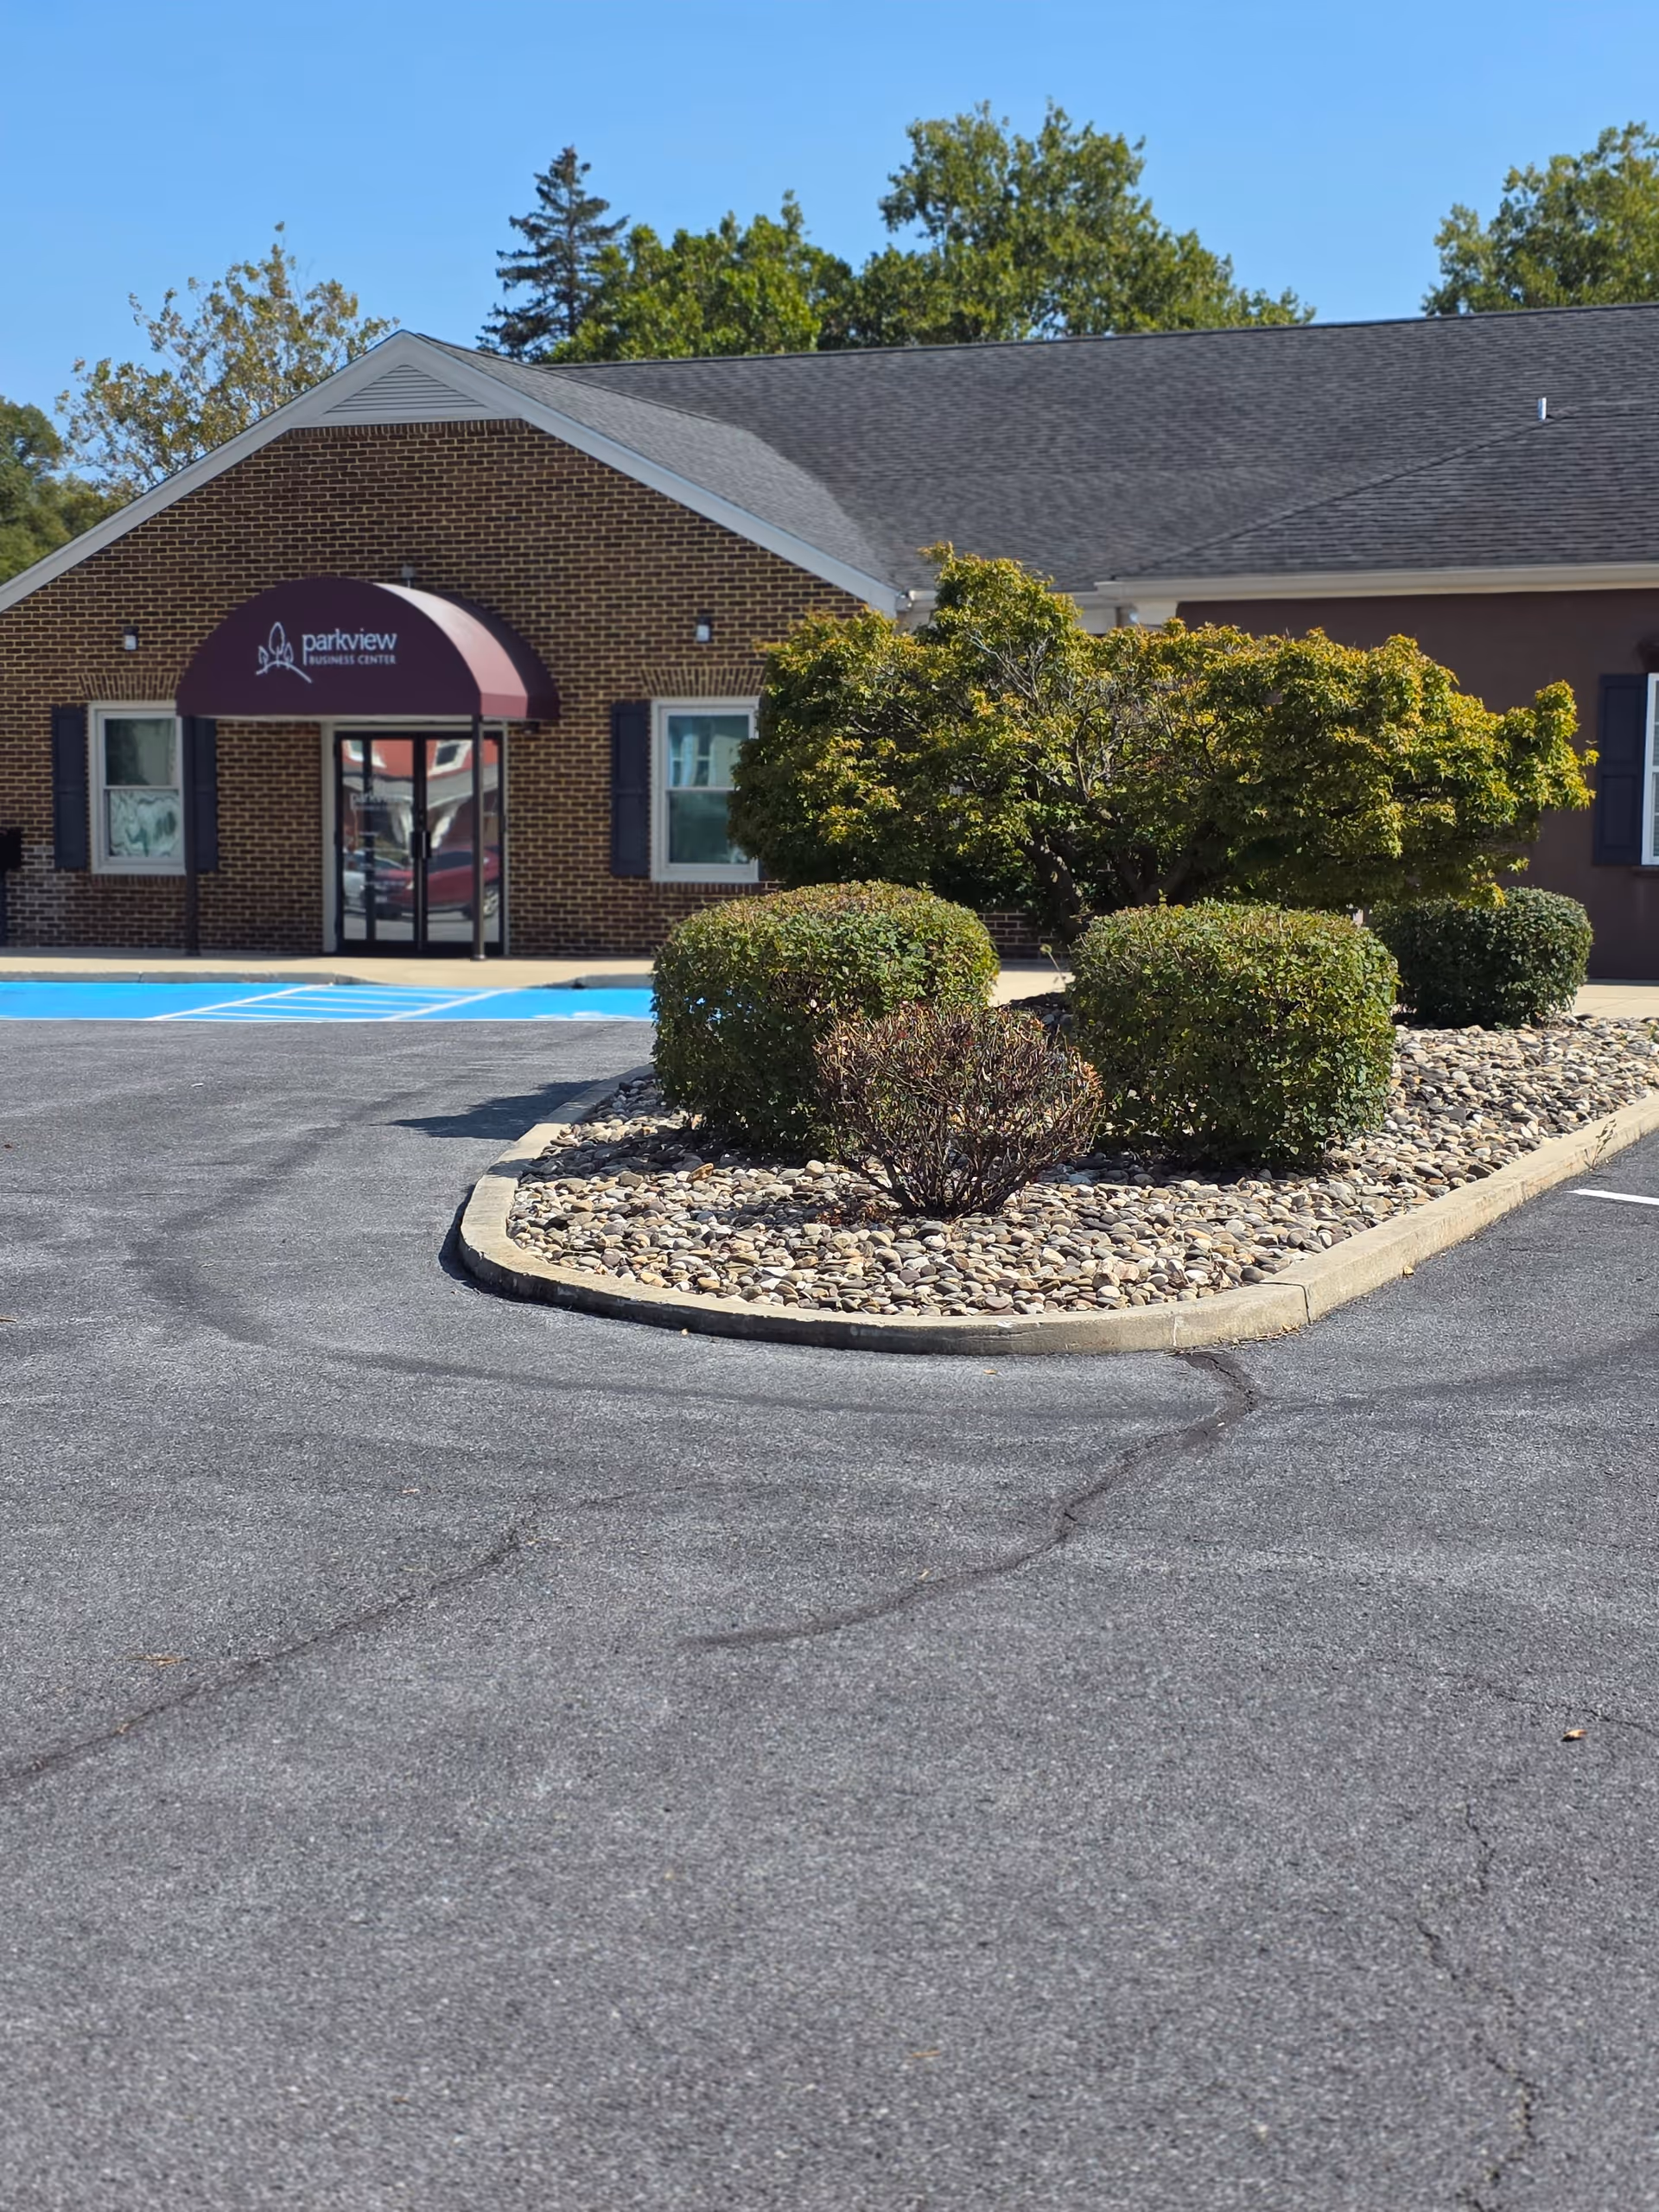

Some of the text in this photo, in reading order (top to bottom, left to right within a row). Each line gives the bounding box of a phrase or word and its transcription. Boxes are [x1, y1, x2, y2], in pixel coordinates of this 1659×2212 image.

[302, 628, 397, 665] parkview
[308, 654, 397, 664] BUSINESS CENTER
